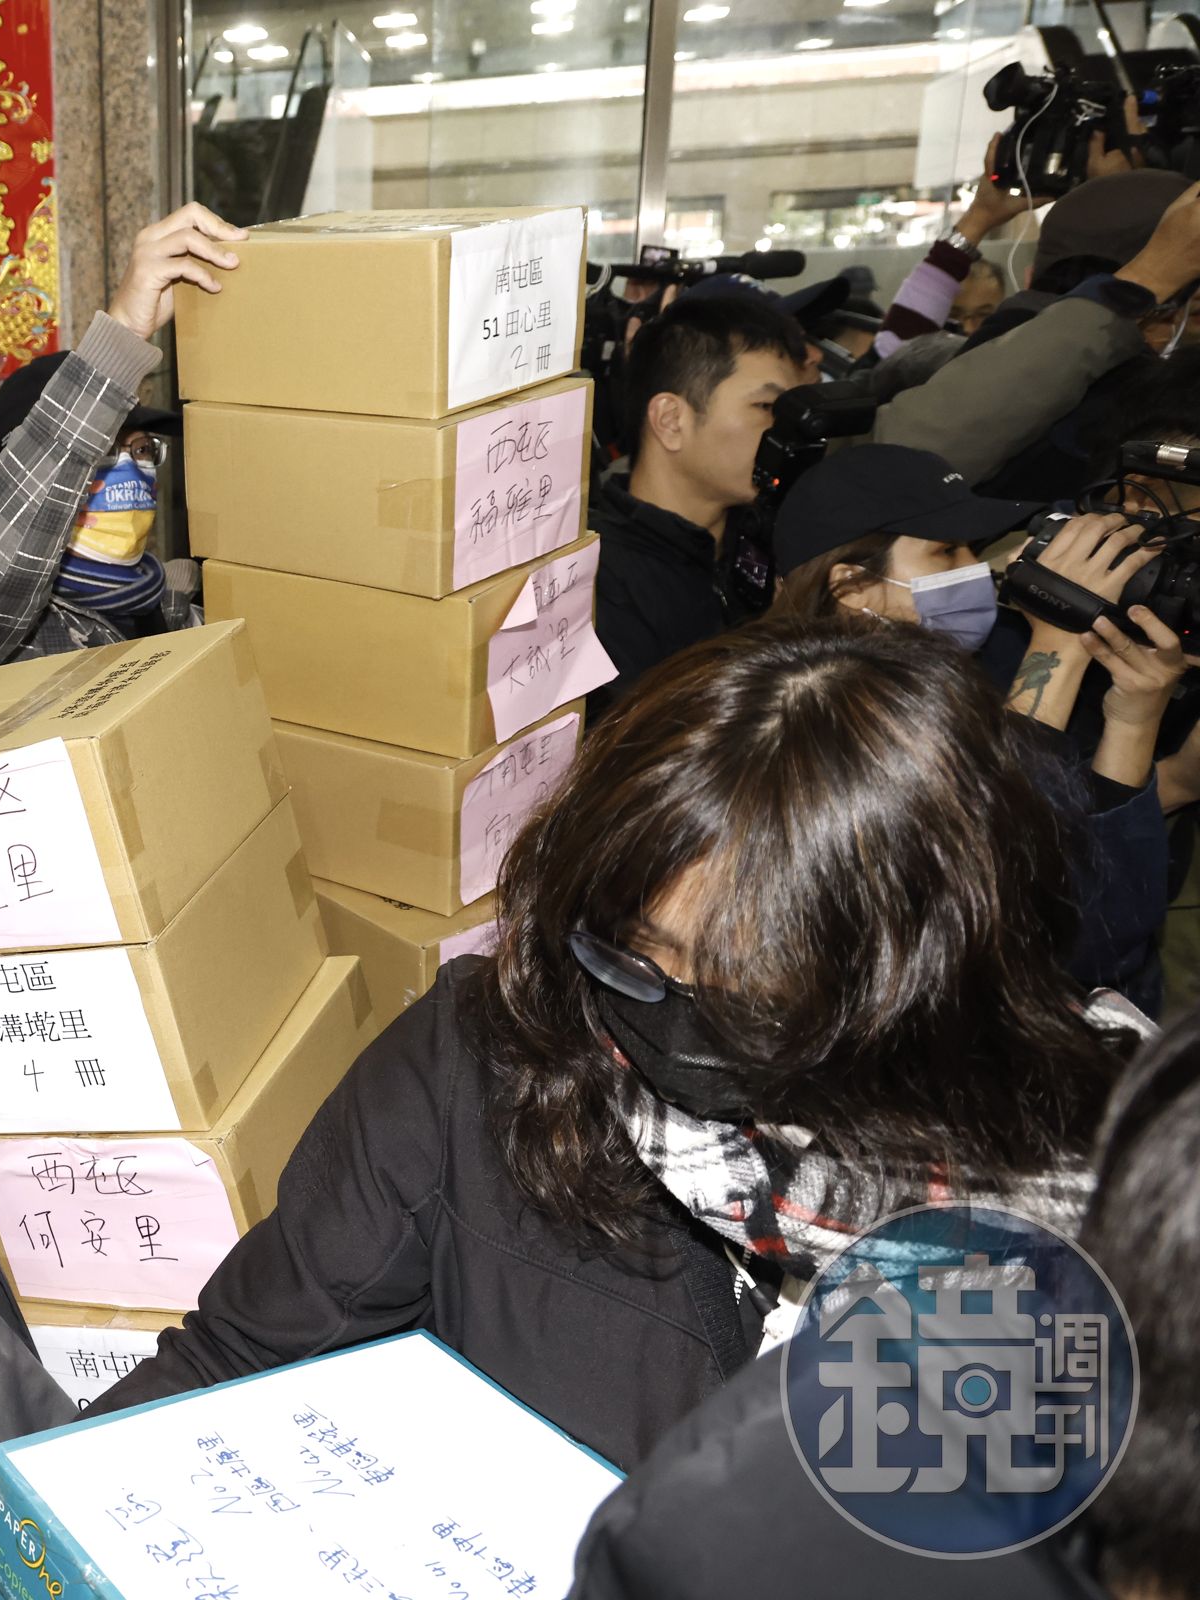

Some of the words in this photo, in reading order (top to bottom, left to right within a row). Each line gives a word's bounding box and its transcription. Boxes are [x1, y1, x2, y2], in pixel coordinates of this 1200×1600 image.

[495, 256, 543, 295] 南屯區
[483, 317, 500, 340] 51
[505, 300, 551, 339] 田心里
[536, 343, 551, 373] 冊
[105, 480, 138, 492] STAND
[105, 488, 153, 503] UKRAIN
[1028, 584, 1072, 611] SONY
[23, 1059, 45, 1092] 4
[74, 1058, 106, 1087] 冊
[18, 1210, 179, 1268] 何安里
[66, 1349, 159, 1379] 南屯
